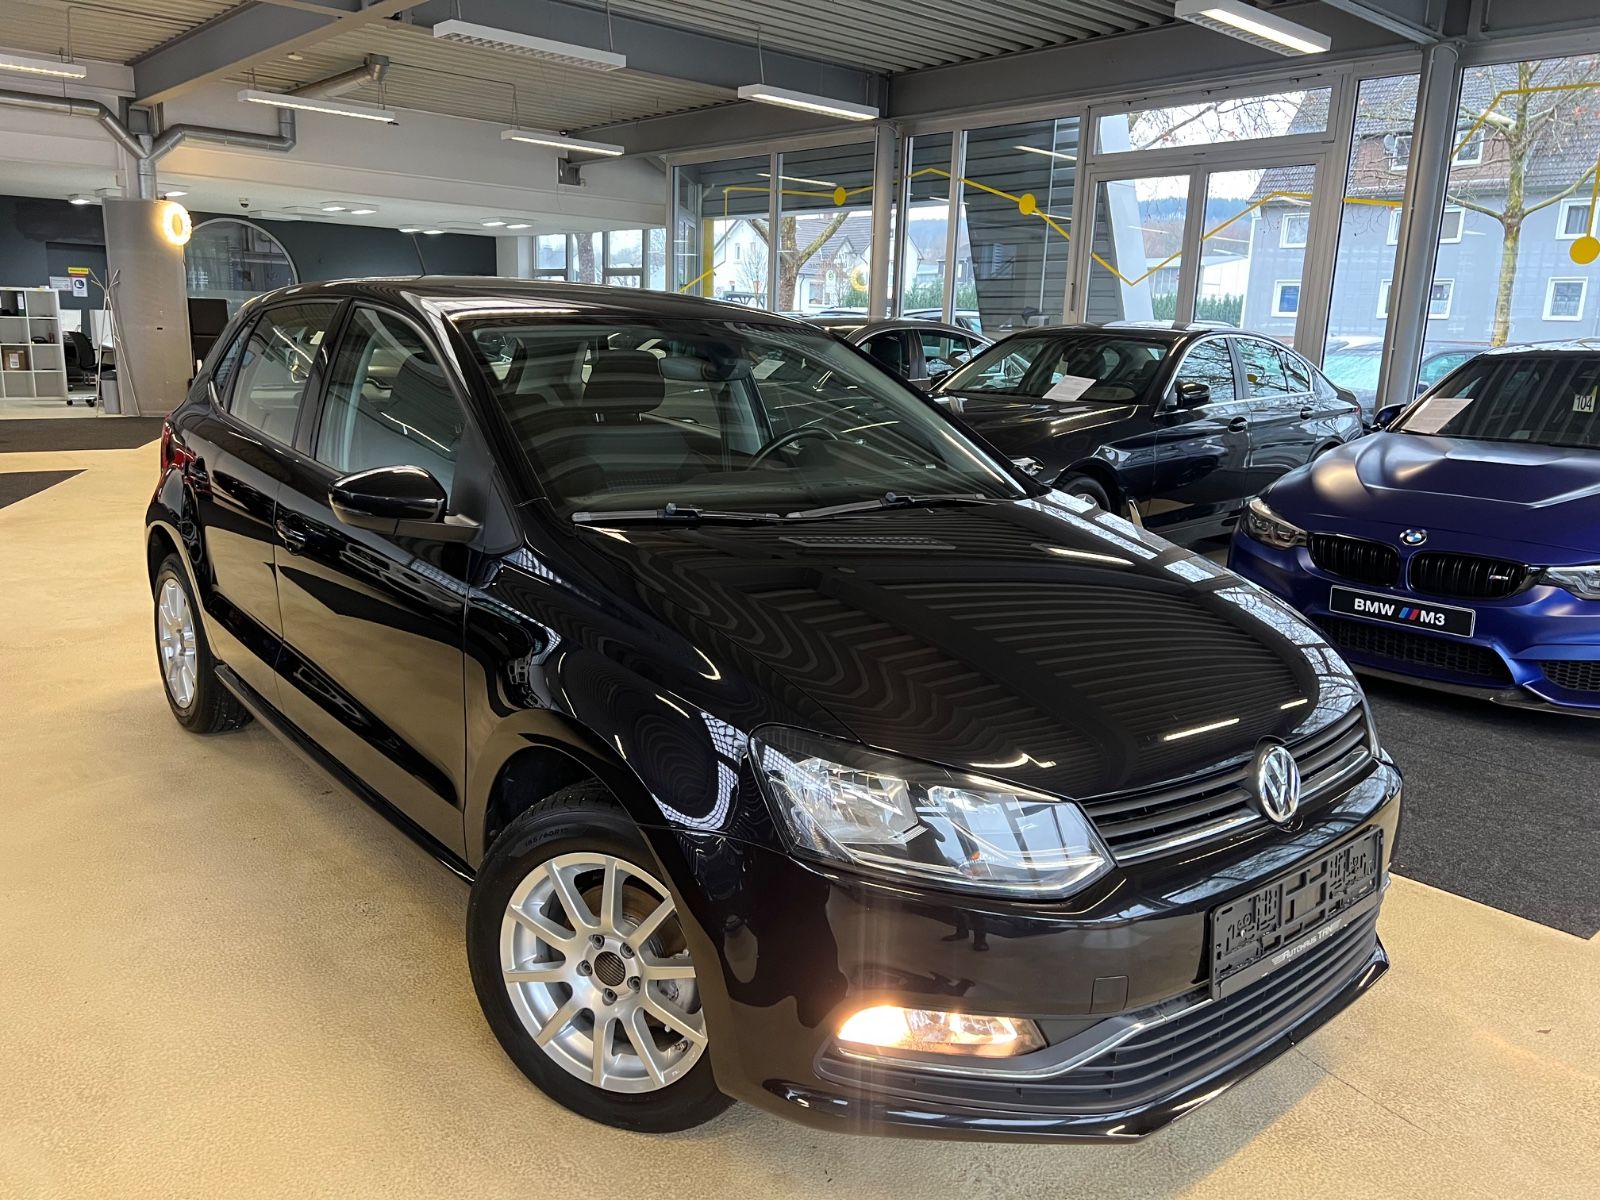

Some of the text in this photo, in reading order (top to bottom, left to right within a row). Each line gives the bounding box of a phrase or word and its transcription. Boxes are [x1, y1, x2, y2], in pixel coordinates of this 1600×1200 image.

[1576, 395, 1592, 410] 104
[1354, 598, 1445, 626] BMW M3
